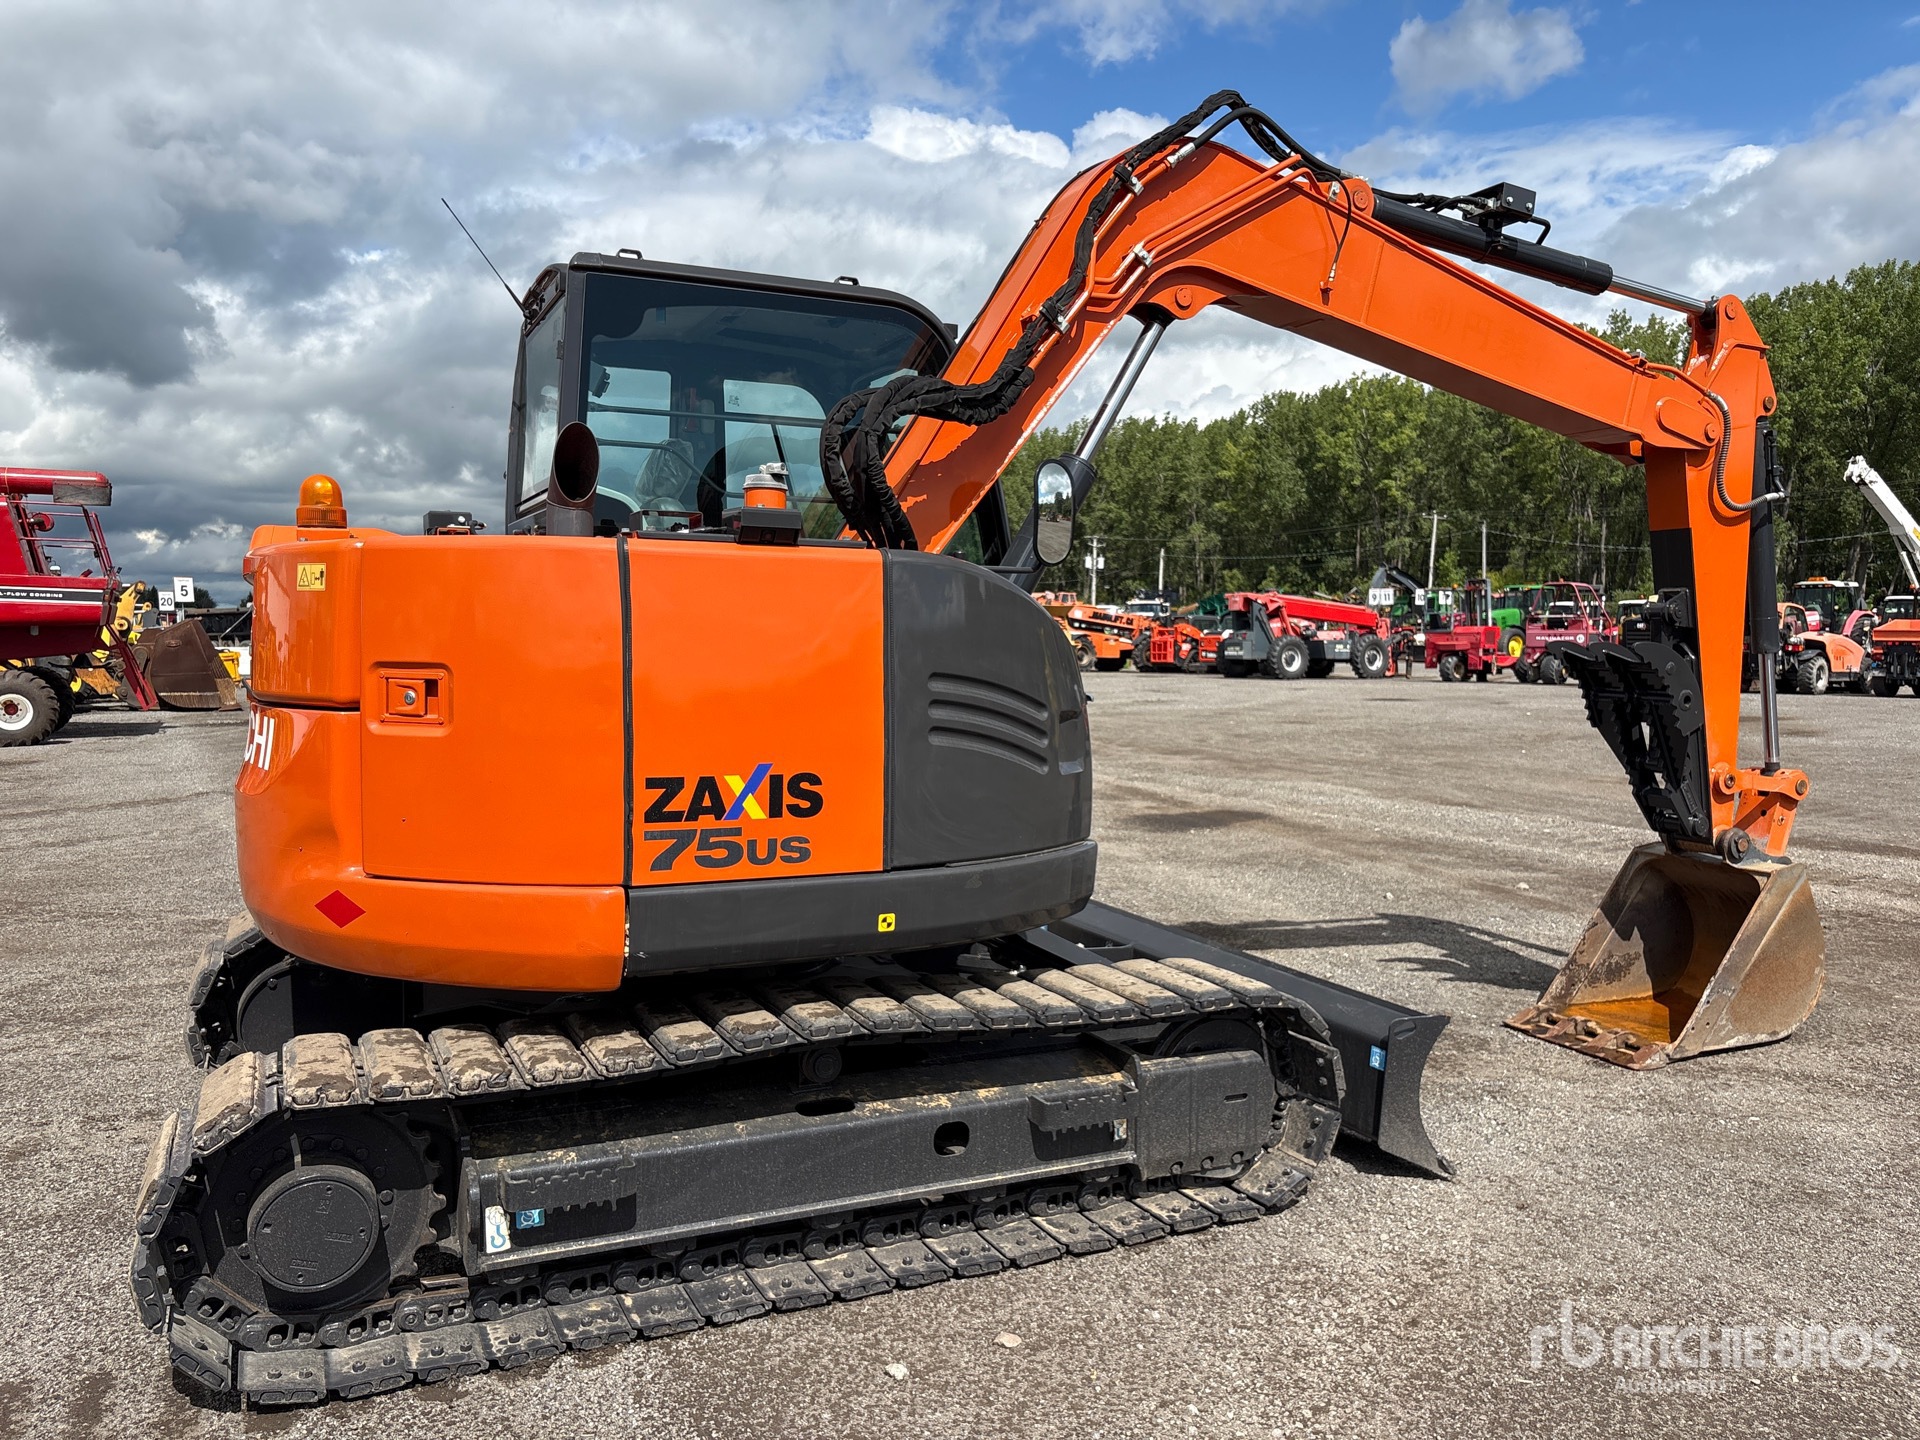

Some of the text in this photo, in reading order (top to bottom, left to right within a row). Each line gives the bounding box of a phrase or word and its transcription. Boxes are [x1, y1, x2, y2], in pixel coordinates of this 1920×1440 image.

[180, 585, 189, 597] 5
[160, 597, 173, 607] 20
[1384, 593, 1391, 602] 11
[643, 762, 824, 824] ZAXIS
[643, 826, 812, 873] 75US
